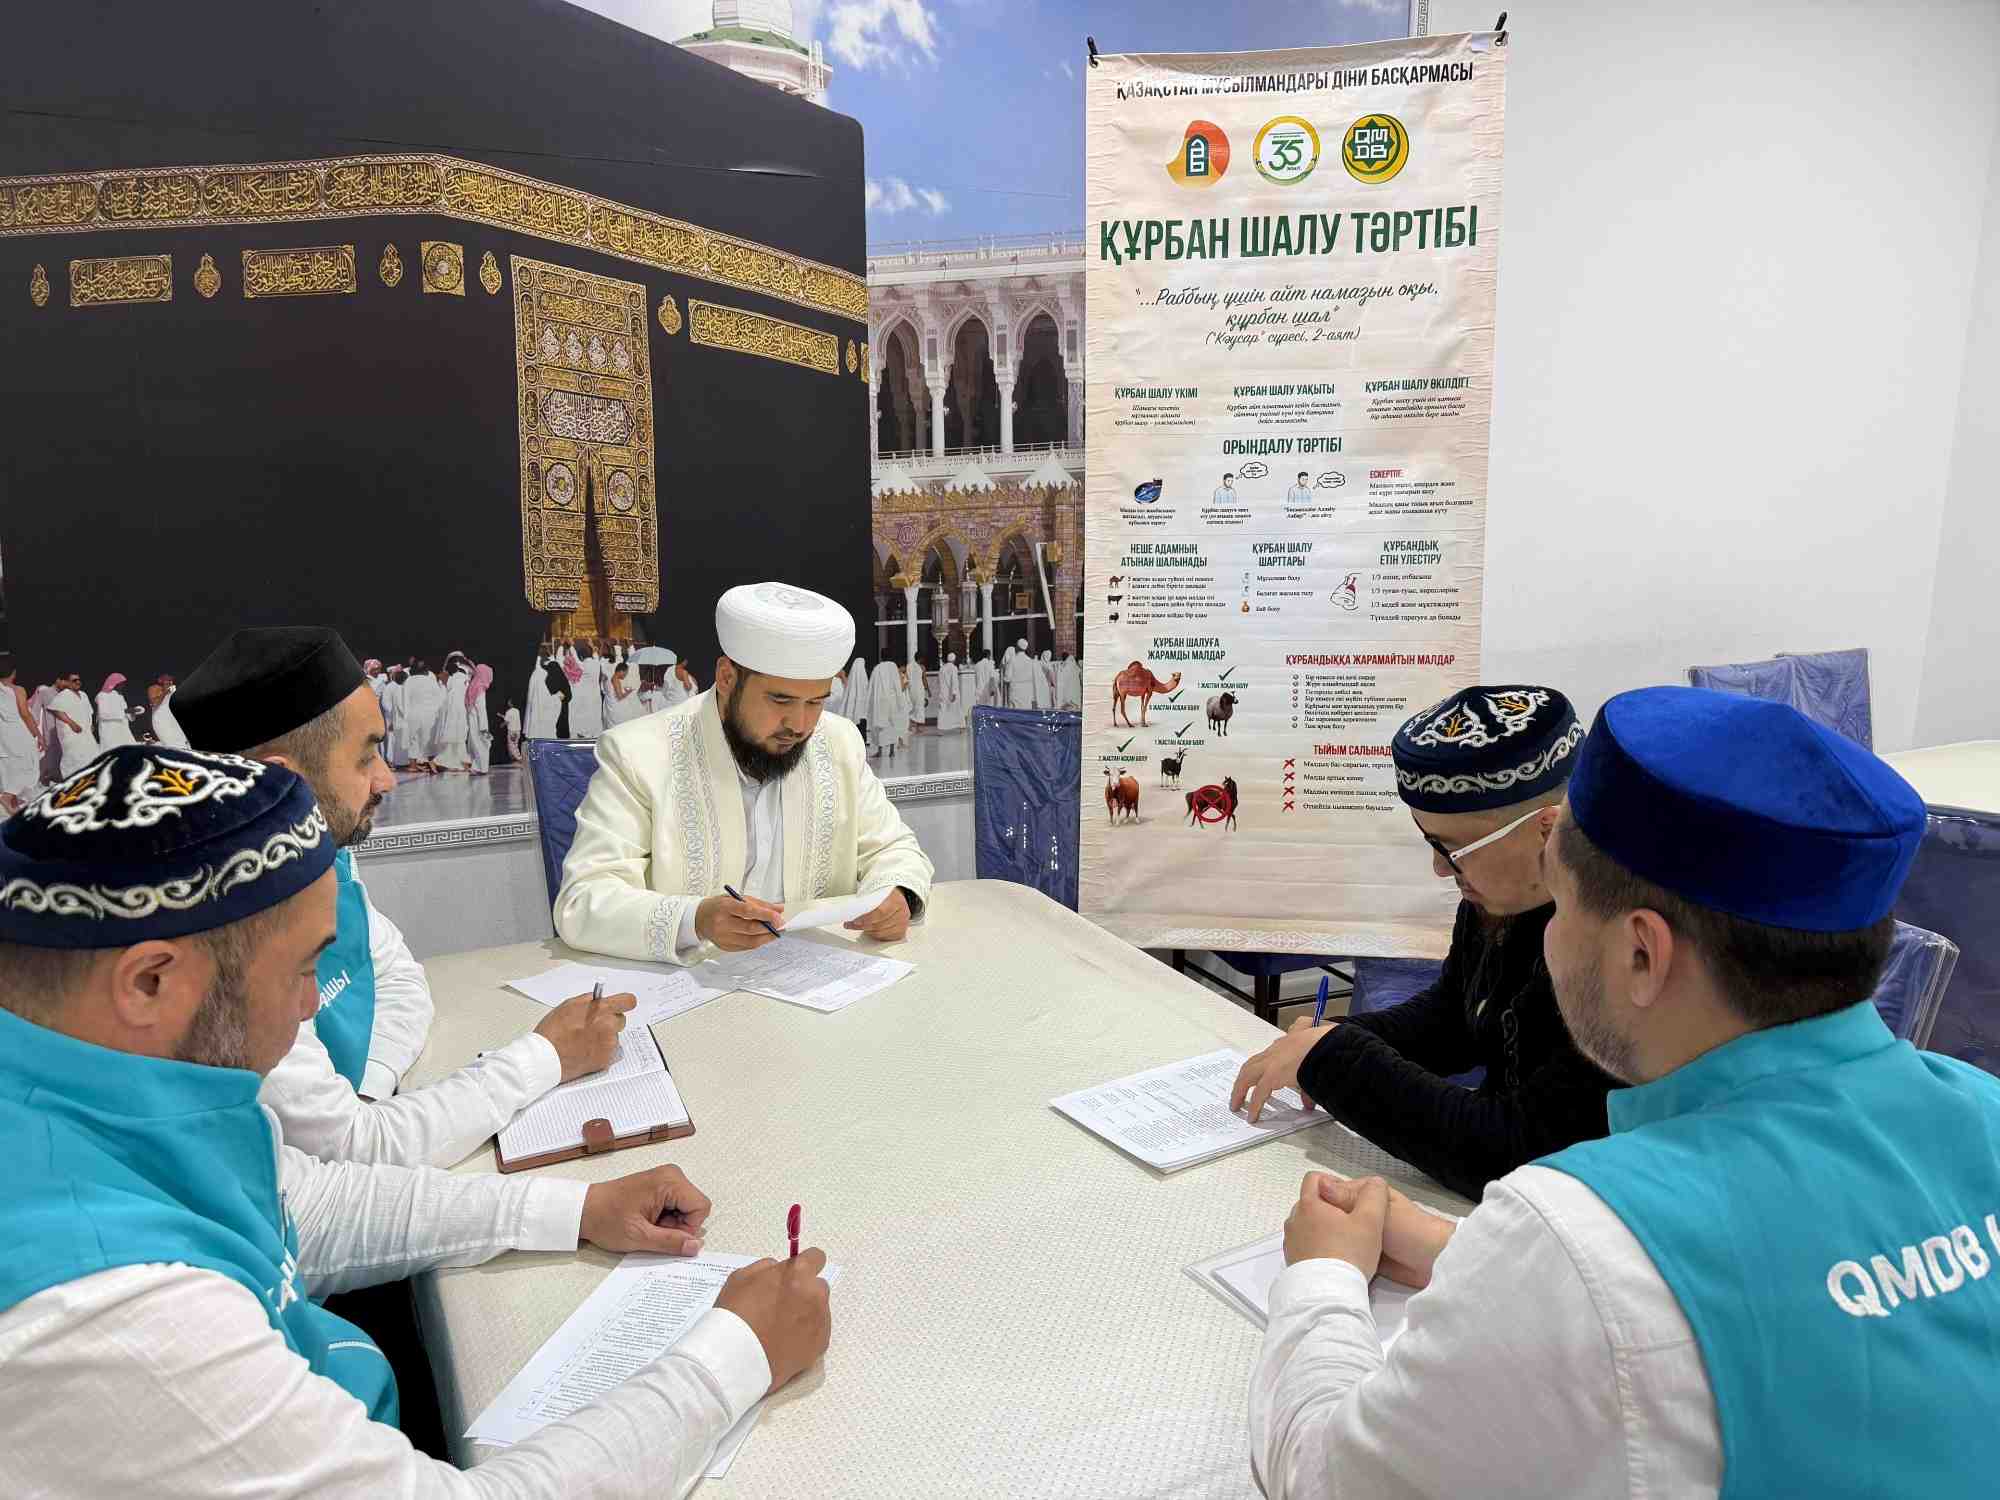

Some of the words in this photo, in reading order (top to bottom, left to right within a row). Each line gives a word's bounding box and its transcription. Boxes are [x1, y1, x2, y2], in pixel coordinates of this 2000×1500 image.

[1332, 69, 1367, 90] ДІНИ
[1371, 62, 1473, 86] БАСҚАРМАСЫ
[1269, 140, 1304, 171] 35
[1100, 217, 1229, 266] ҚҰРБАН
[1240, 213, 1341, 258] ШАЛУ
[1351, 205, 1478, 253] ТӘРТІБІ
[1224, 289, 1265, 309] үшін
[1270, 284, 1307, 301] айт
[1311, 286, 1393, 306] намазын
[1226, 307, 1287, 331] құрбан
[1312, 326, 1360, 341] 2-аят)
[1233, 385, 1267, 397] ҚҰРБАН
[1269, 384, 1295, 396] ШАЛУ
[1296, 383, 1335, 396] УАҚЫТЫ
[1365, 380, 1400, 393] ҚҰРБАН
[1402, 378, 1429, 390] ШАЛУ
[1114, 387, 1147, 399] ҚҰРБАН
[1148, 387, 1173, 399] ШАЛУ
[1174, 387, 1198, 399] ҮКІМІ
[1223, 438, 1294, 457] ОРЫНДАЛУ
[1297, 437, 1342, 453] ТӘРТІБІ
[1130, 543, 1153, 554] НЕШЕ
[1154, 543, 1198, 555] АДАМНЫҢ
[1252, 543, 1286, 555] ҚҰРБАН
[1287, 542, 1313, 553] ШАЛУ
[1383, 540, 1439, 553] ҚҰРБАНДЫҚ
[1120, 556, 1154, 568] АТЫНАН
[1155, 556, 1208, 568] ШАЛЫНАДЫ
[1258, 555, 1305, 567] ШАРТТАРЫ
[1380, 554, 1399, 565] ЕТІН
[1401, 553, 1442, 565] ҮЛЕСТІРУ
[1153, 637, 1185, 649] ҚҰРБАН
[1186, 637, 1220, 648] ШАЛУҒА
[1148, 650, 1190, 662] ЖАРАМДЫ
[1191, 650, 1226, 662] МАЛДАР
[1286, 654, 1351, 667] ҚҰРБАНДЫҚҚА
[1353, 653, 1415, 665] ЖАРАМАЙТЫН
[1417, 654, 1456, 666] МАЛДАР
[1313, 743, 1347, 756] ТЫЙЫМ
[1349, 745, 1392, 758] САЛЫНАД
[1827, 1224, 1991, 1317] QMDB
